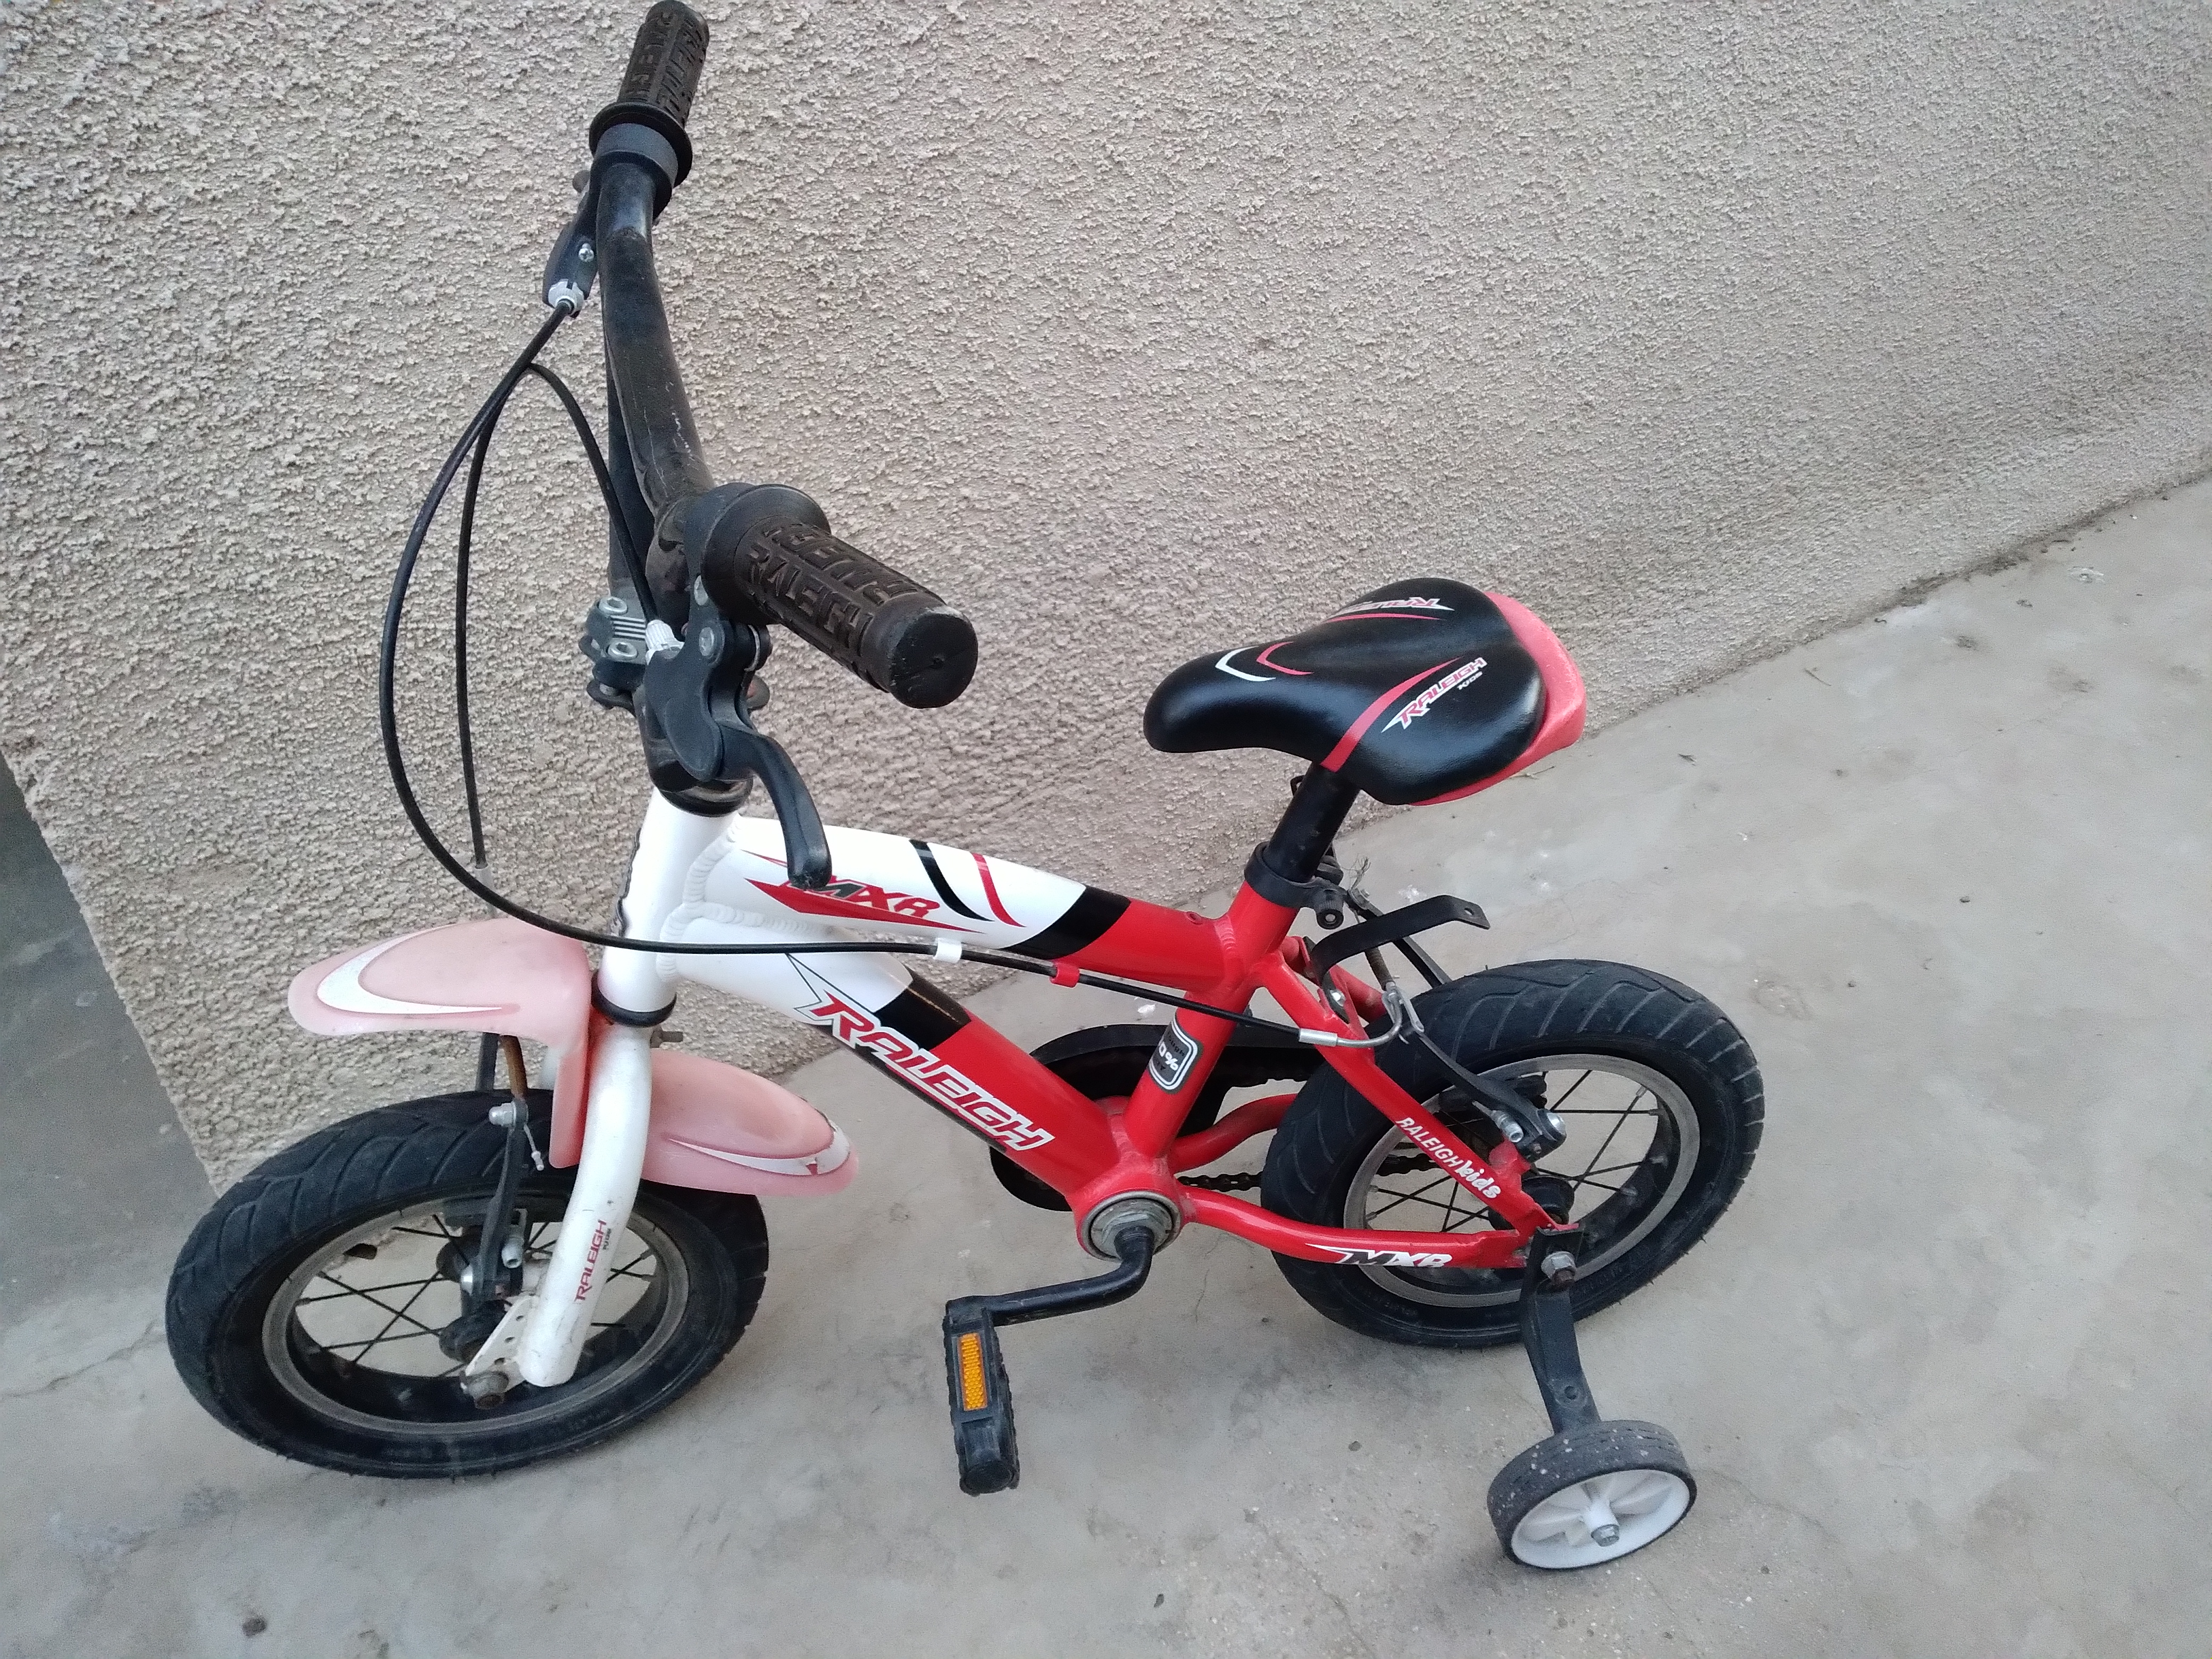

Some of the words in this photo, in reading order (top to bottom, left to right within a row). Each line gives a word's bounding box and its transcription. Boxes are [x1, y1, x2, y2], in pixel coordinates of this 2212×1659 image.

[1396, 657, 1488, 730] RALEIGH
[803, 979, 1055, 1151] RALEIGH
[1395, 1117, 1464, 1168] RALEIGH
[574, 1220, 607, 1302] RALEIGH
